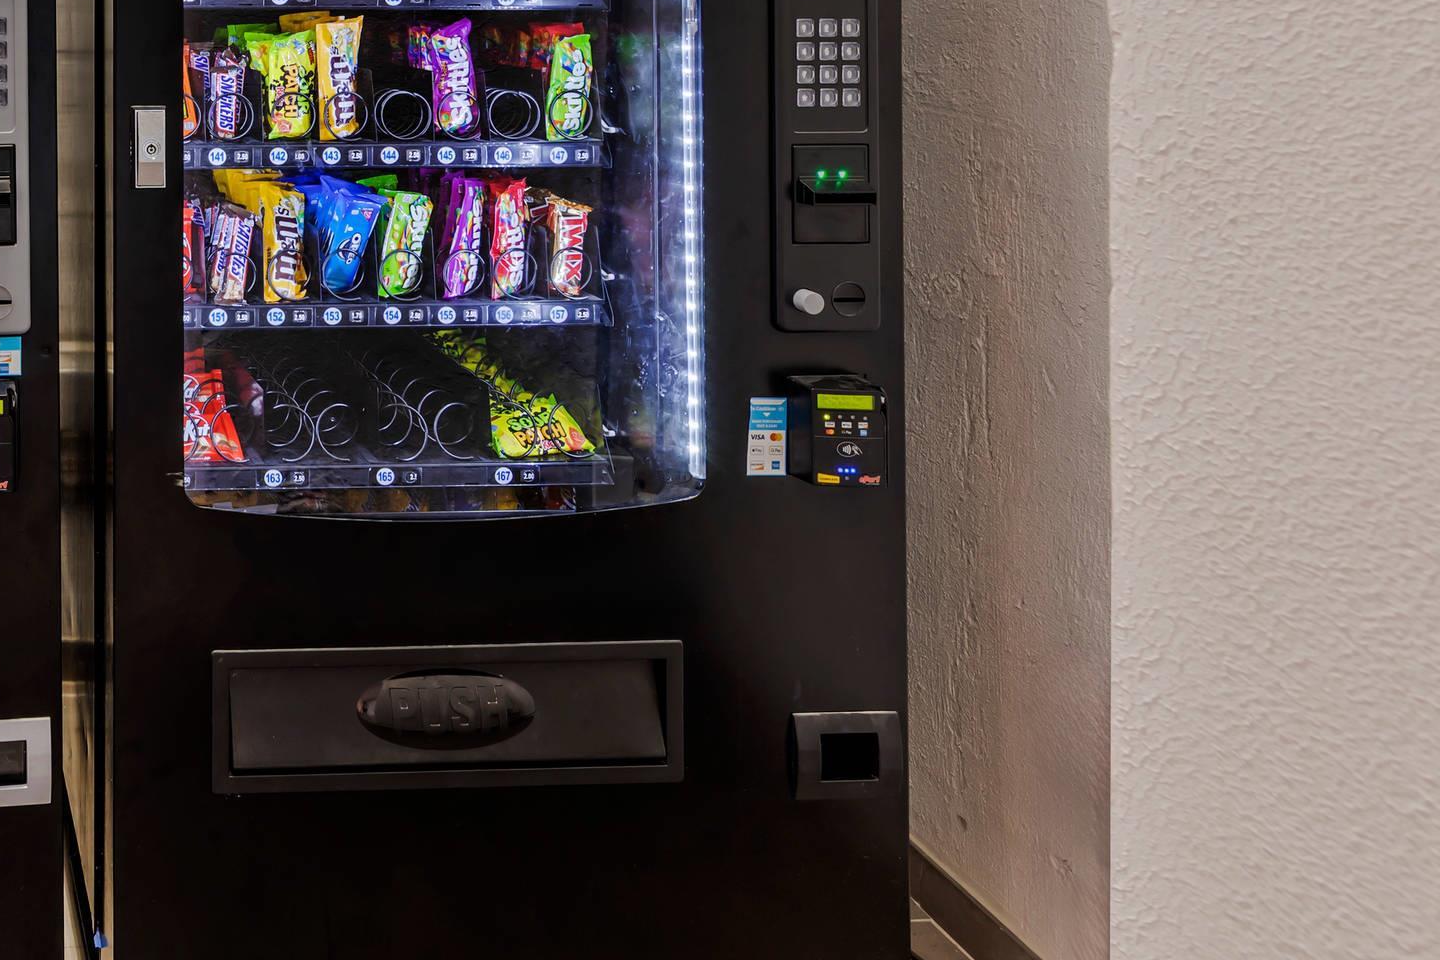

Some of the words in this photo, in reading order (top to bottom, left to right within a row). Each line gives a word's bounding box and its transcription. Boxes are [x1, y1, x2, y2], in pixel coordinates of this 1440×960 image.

[219, 73, 235, 131] SNICKERS
[210, 151, 224, 161] 141
[271, 151, 286, 161] 142
[323, 151, 339, 160] 143
[382, 150, 397, 160] 144
[439, 150, 453, 160] 145
[496, 150, 511, 160] 146
[552, 150, 565, 160] 147
[211, 312, 225, 322] 151
[268, 312, 283, 321] 152
[325, 311, 340, 321] 153
[385, 311, 399, 320] 154
[439, 310, 454, 320] 155
[497, 310, 512, 320] 156
[552, 309, 565, 319] 157
[507, 410, 555, 431] SOUR
[513, 423, 566, 449] PATCH
[266, 472, 281, 482] 163
[378, 471, 393, 481] 165
[496, 471, 511, 481] 167
[388, 685, 509, 733] PUSH
